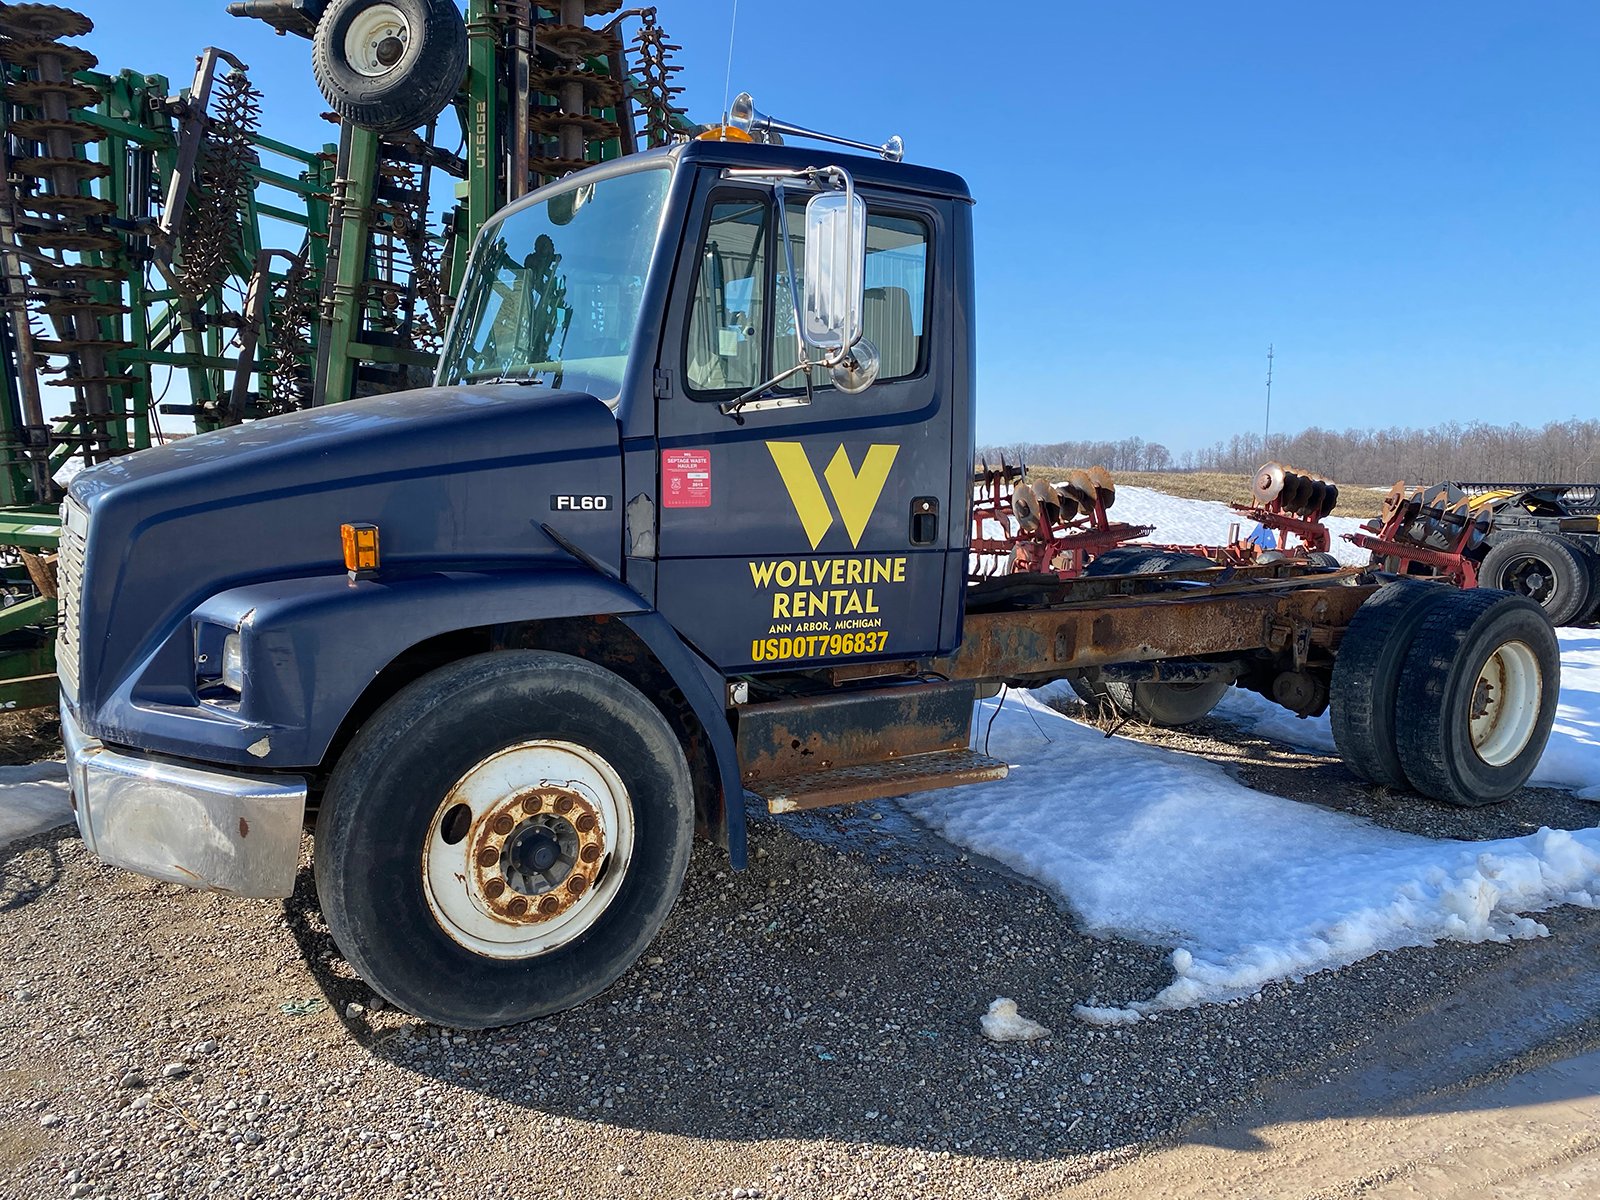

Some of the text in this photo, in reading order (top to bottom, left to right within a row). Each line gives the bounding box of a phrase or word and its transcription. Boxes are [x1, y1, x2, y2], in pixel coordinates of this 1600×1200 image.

[557, 496, 607, 510] FL60
[749, 557, 906, 588] WOLVERINE
[772, 588, 879, 618] RENTAL
[768, 618, 882, 634] ANN ARBOR, MICHIGAN
[751, 630, 889, 661] USDOT796837
